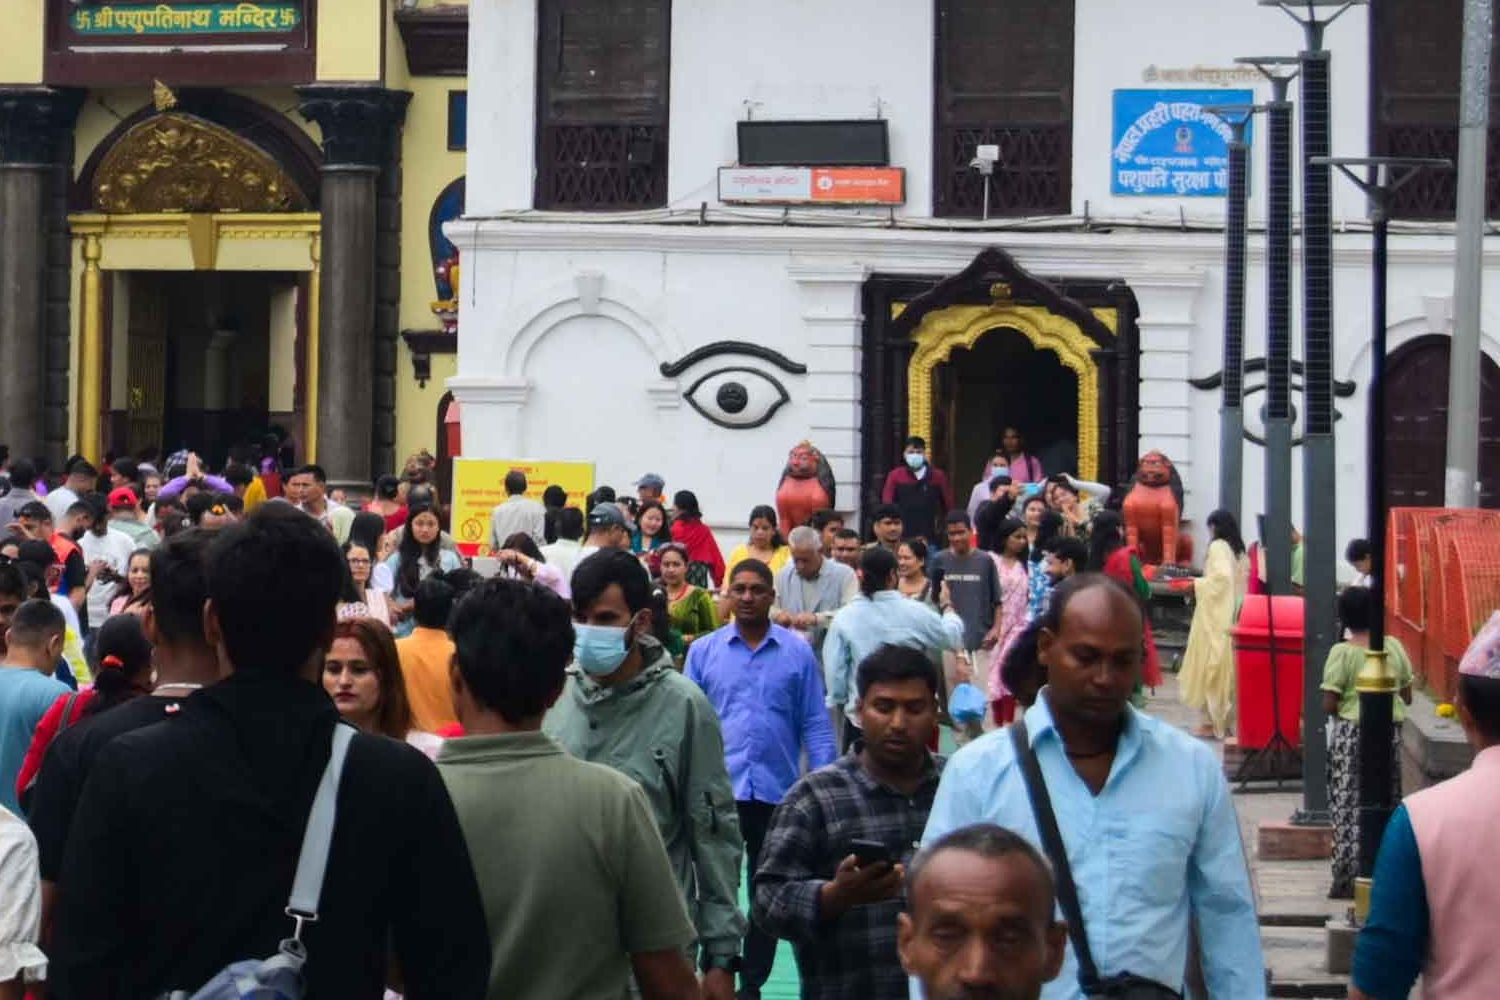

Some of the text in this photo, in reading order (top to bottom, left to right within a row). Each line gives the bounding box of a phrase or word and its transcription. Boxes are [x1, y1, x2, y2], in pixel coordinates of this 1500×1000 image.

[115, 4, 212, 33] पशुपतिनाथ
[219, 3, 278, 28] मन्दिर
[1118, 166, 1169, 192] पशुपति
